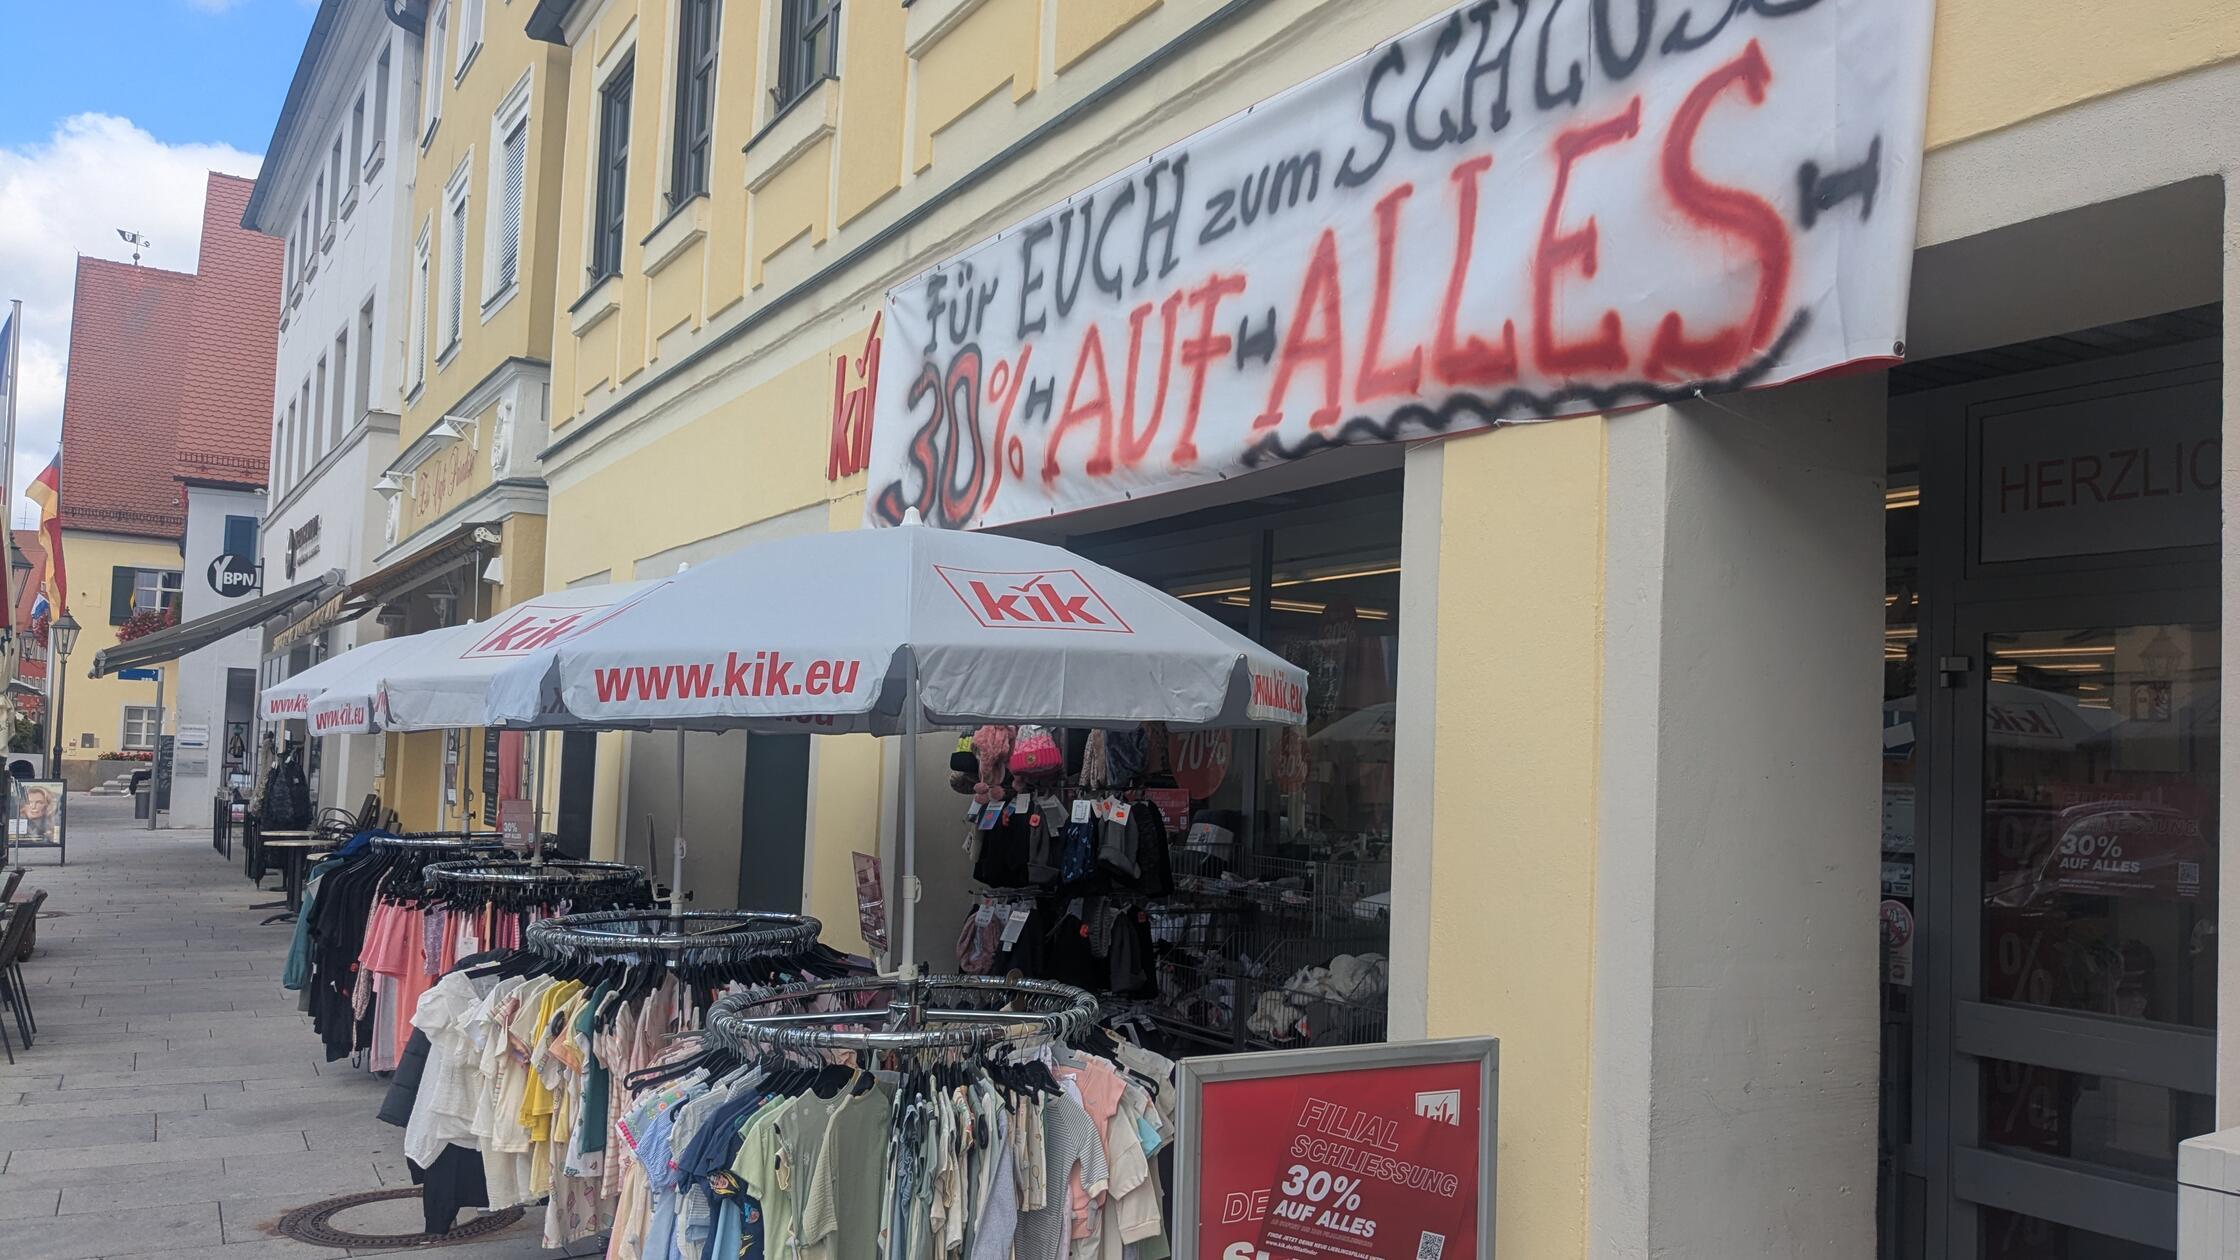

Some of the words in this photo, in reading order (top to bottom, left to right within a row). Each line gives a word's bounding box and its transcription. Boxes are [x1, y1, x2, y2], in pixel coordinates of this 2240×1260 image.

[1018, 152, 1190, 340] EUCH
[1199, 150, 1322, 245] zum
[868, 342, 1033, 530] 30%
[1042, 274, 1247, 484] AUF
[1252, 38, 1789, 430] ALLES
[967, 575, 1106, 624] kik
[476, 609, 590, 652] kik
[594, 651, 861, 702] www.kik.eu
[2060, 834, 2122, 858] 30%
[2060, 858, 2090, 870] AUF
[2092, 860, 2141, 873] ALLES
[1297, 1097, 1399, 1152] FILIAL
[1281, 1164, 1361, 1211] 30%
[1290, 1134, 1458, 1198] SCHLIESSUNG
[1273, 1199, 1317, 1222] AUF
[1315, 1209, 1377, 1239] ALLES
